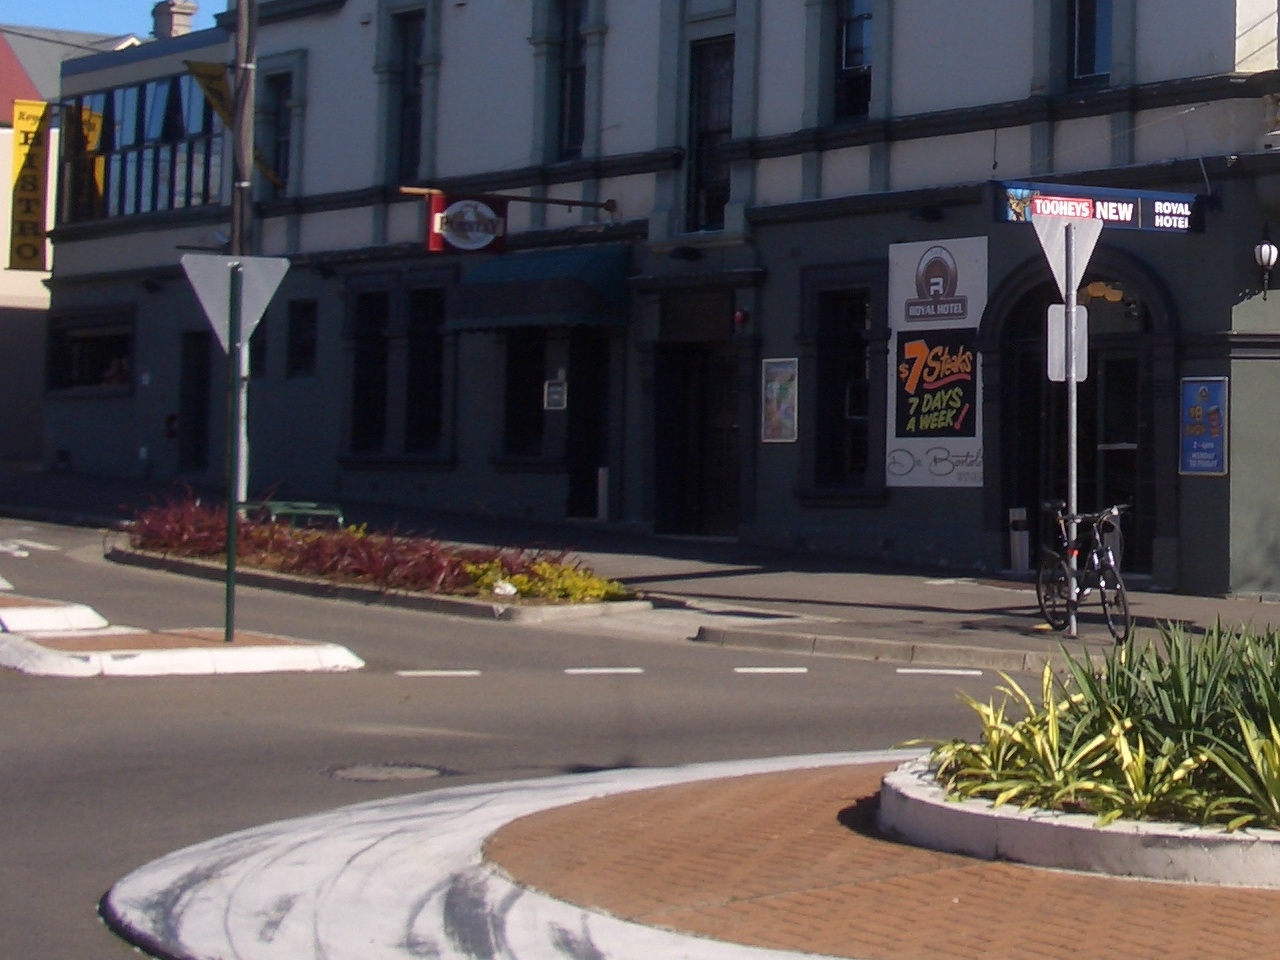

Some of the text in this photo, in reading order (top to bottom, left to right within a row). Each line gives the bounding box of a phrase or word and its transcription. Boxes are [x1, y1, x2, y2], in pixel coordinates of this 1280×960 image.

[1034, 199, 1134, 222] TOOHEYS NEW
[1154, 201, 1192, 215] ROYAL
[908, 303, 963, 316] ROYAL HOTEL
[923, 344, 973, 382] Steaks
[908, 386, 963, 415] 7 DAYS
[906, 416, 916, 432] A
